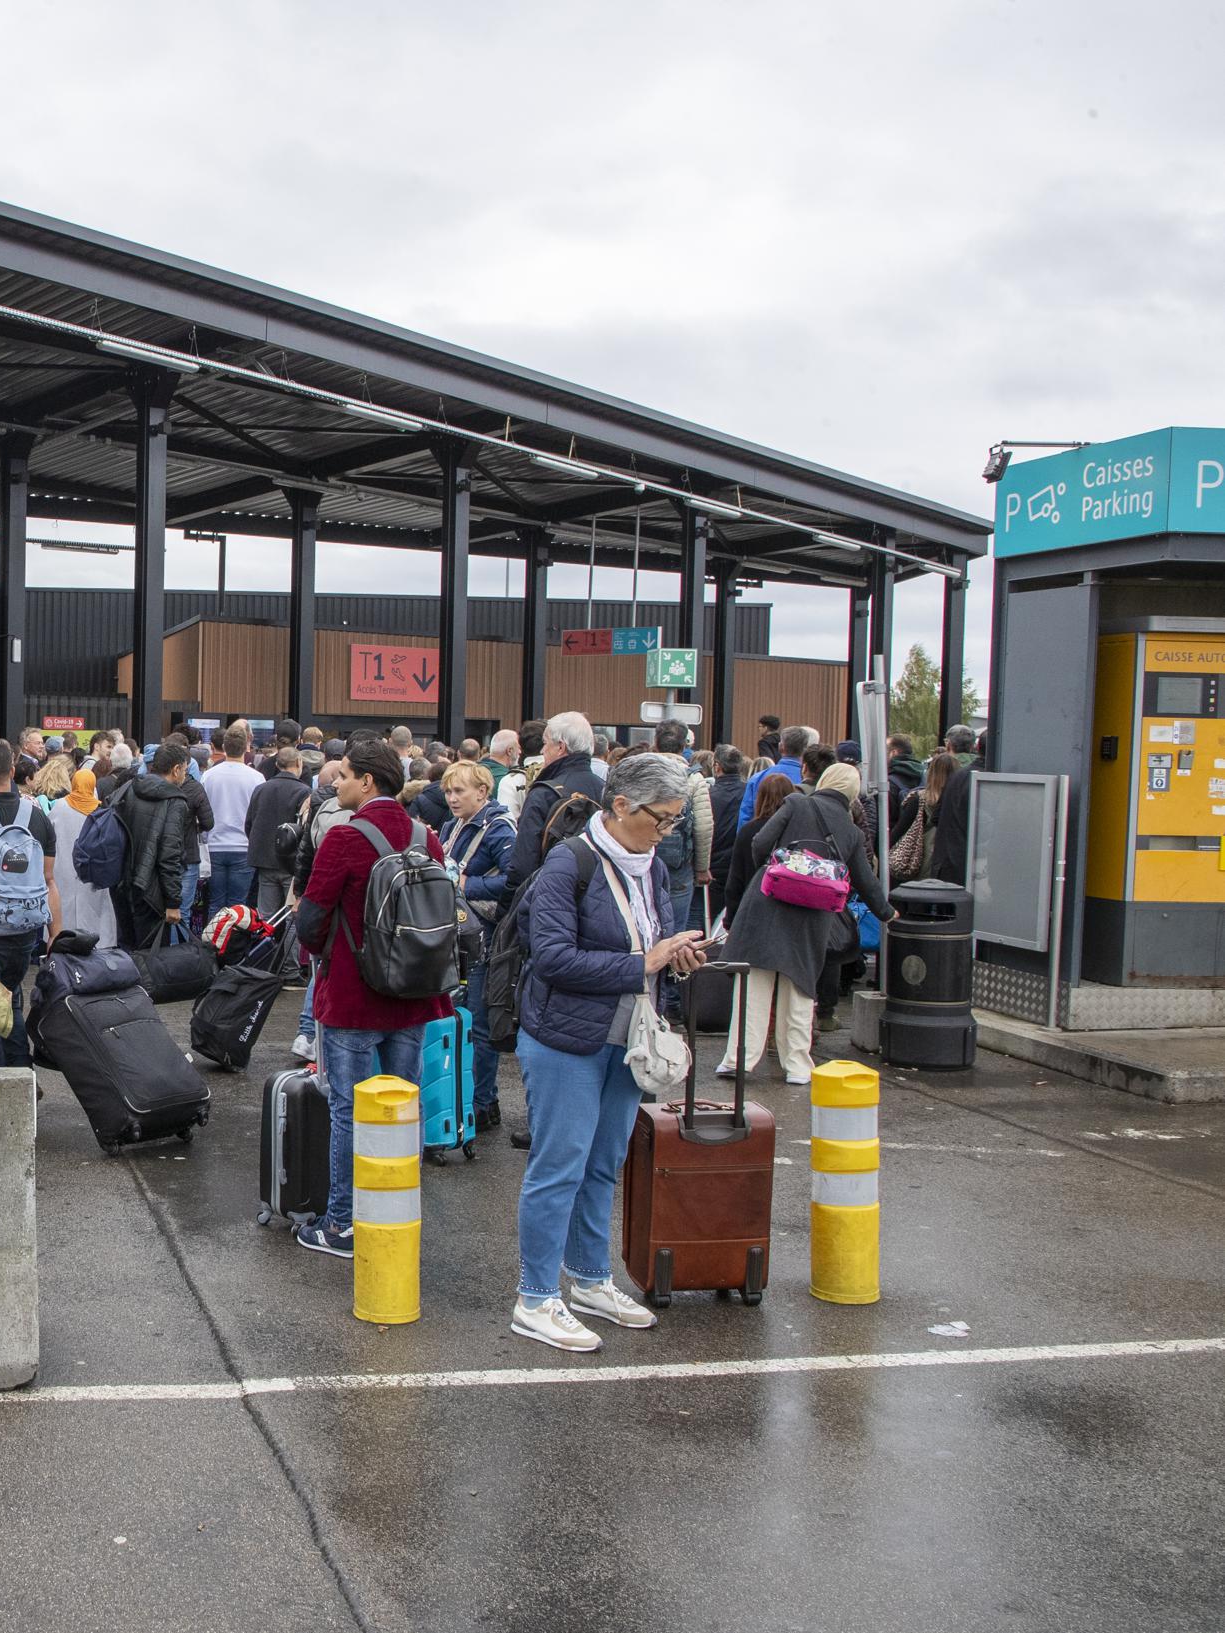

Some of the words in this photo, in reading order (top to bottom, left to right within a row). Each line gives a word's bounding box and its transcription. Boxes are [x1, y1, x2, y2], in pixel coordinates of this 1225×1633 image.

[1082, 455, 1154, 488] Caisses
[1195, 460, 1225, 509] P
[1005, 493, 1021, 533] P
[1081, 490, 1154, 522] Parking
[582, 631, 597, 647] T1
[359, 651, 385, 681] T1
[1154, 651, 1194, 663] CAISSE
[378, 685, 408, 697] Terminal
